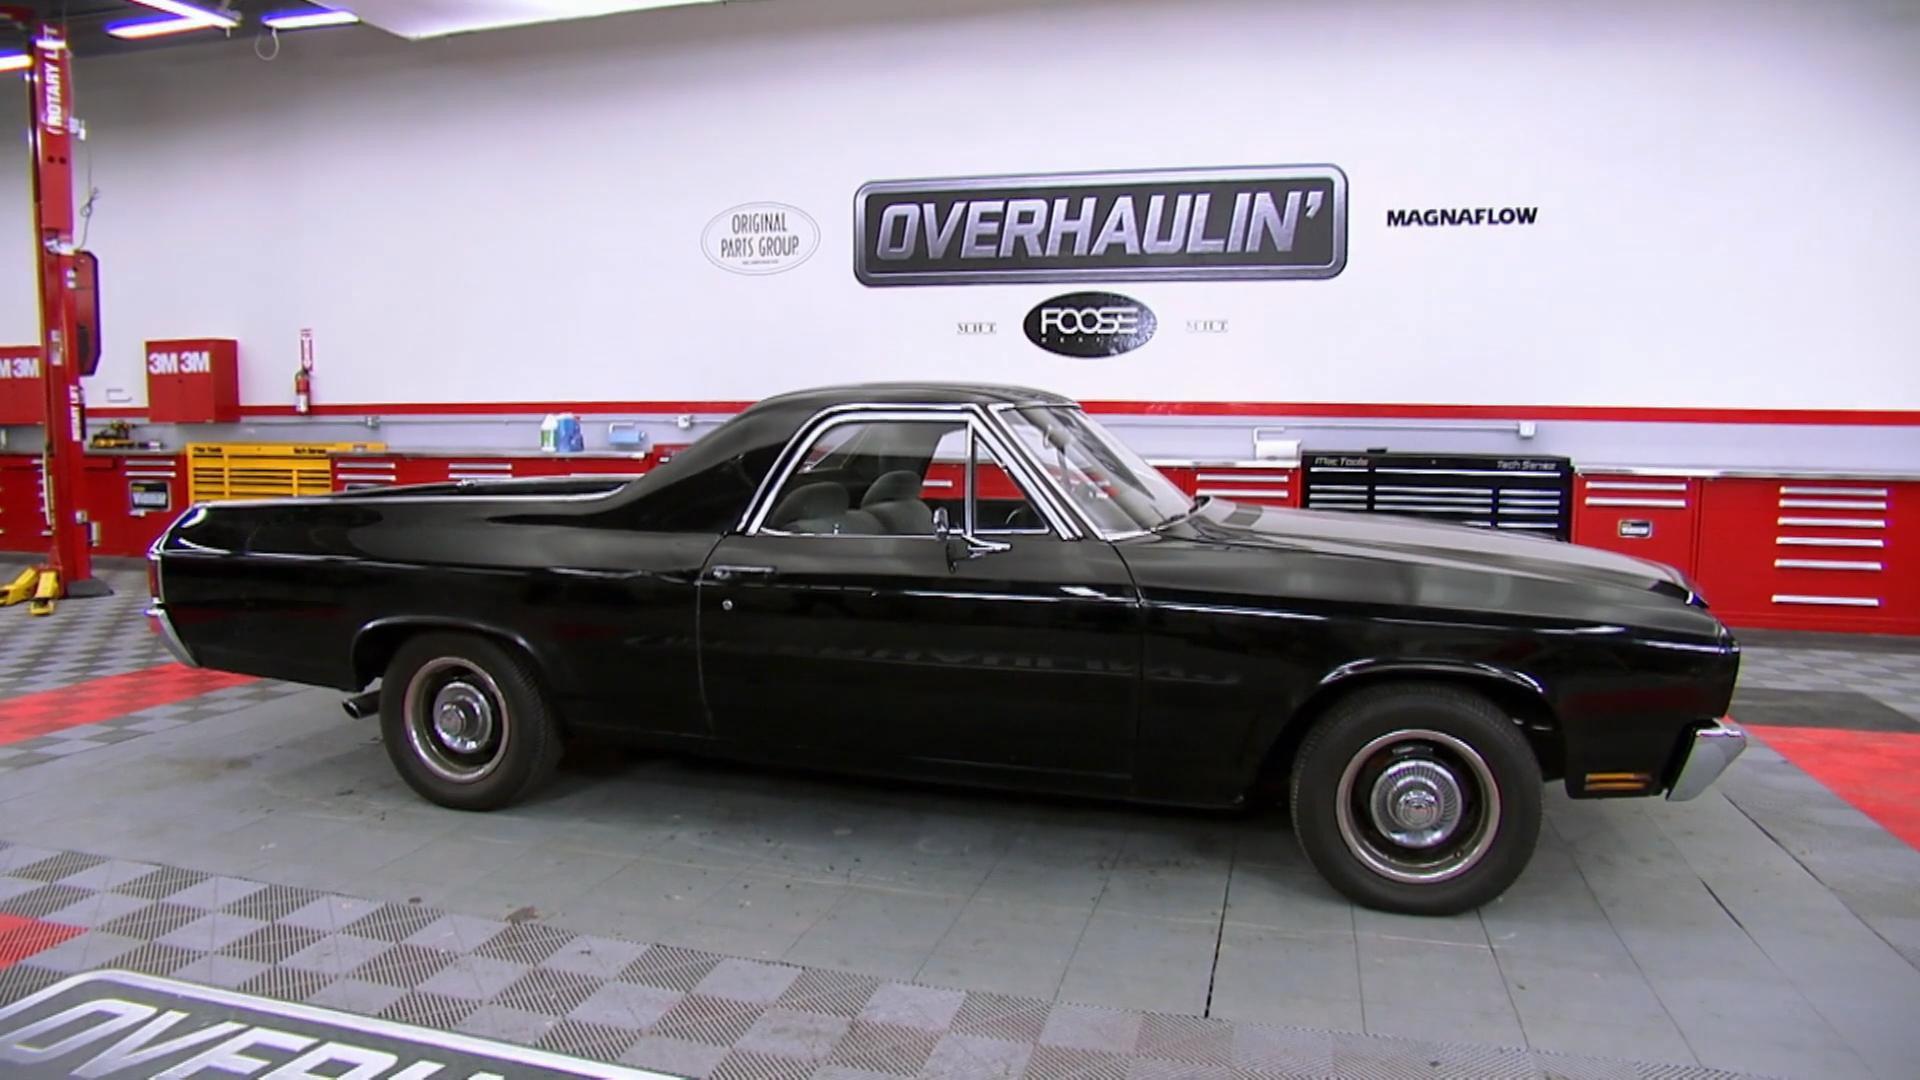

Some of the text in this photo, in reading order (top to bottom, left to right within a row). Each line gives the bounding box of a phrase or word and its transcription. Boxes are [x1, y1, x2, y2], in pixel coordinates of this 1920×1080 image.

[44, 62, 62, 127] ROTARY
[731, 212, 787, 235] ORIGINAL
[1386, 207, 1538, 227] MAGNAFLOW
[720, 235, 800, 258] PARTS GROUP
[1041, 307, 1138, 335] FOOSE
[13, 357, 41, 378] 3M
[149, 351, 210, 374] 3M 3M
[0, 998, 505, 1080] OVER
